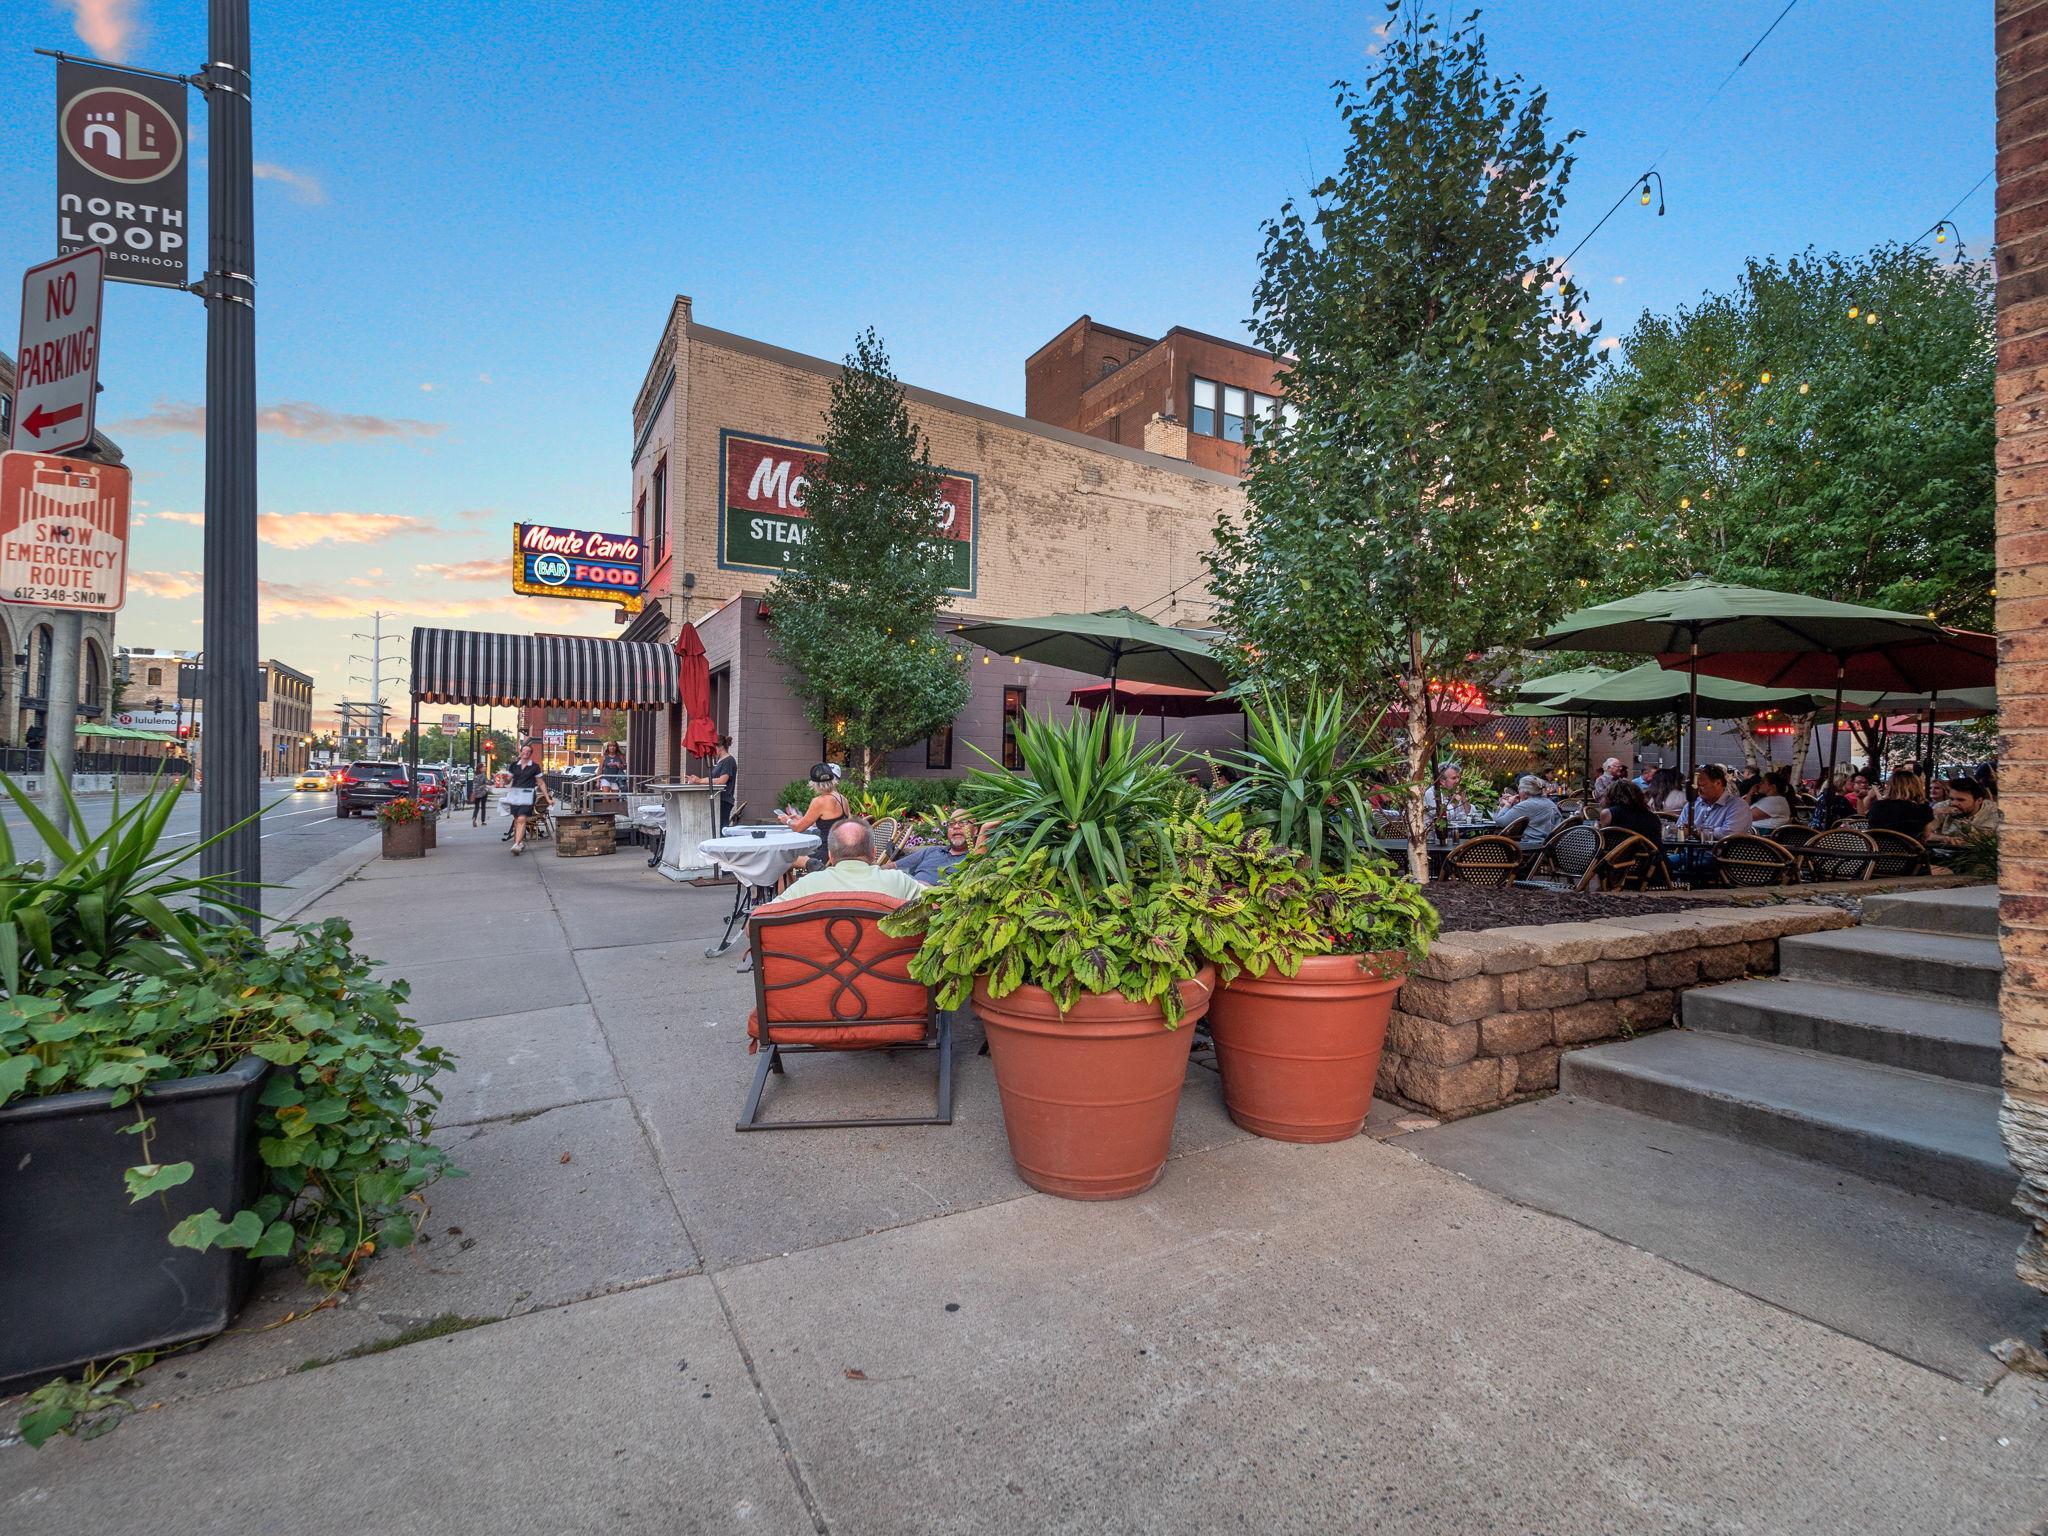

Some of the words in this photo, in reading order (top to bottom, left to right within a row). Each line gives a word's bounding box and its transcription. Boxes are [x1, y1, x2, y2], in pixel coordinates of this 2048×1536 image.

[60, 216, 184, 253] LOOP
[46, 271, 77, 323] NO
[19, 325, 94, 390] PARKING
[36, 523, 93, 546] SNOW
[523, 525, 584, 554] Monte
[585, 533, 639, 560] Carlo
[6, 542, 118, 570] EMERGENCY
[30, 566, 93, 588] ROUTE
[538, 561, 566, 577] BAR
[575, 564, 639, 585] FOOD
[14, 587, 107, 604] 612-348-SNOW
[135, 716, 180, 725] lululemo
